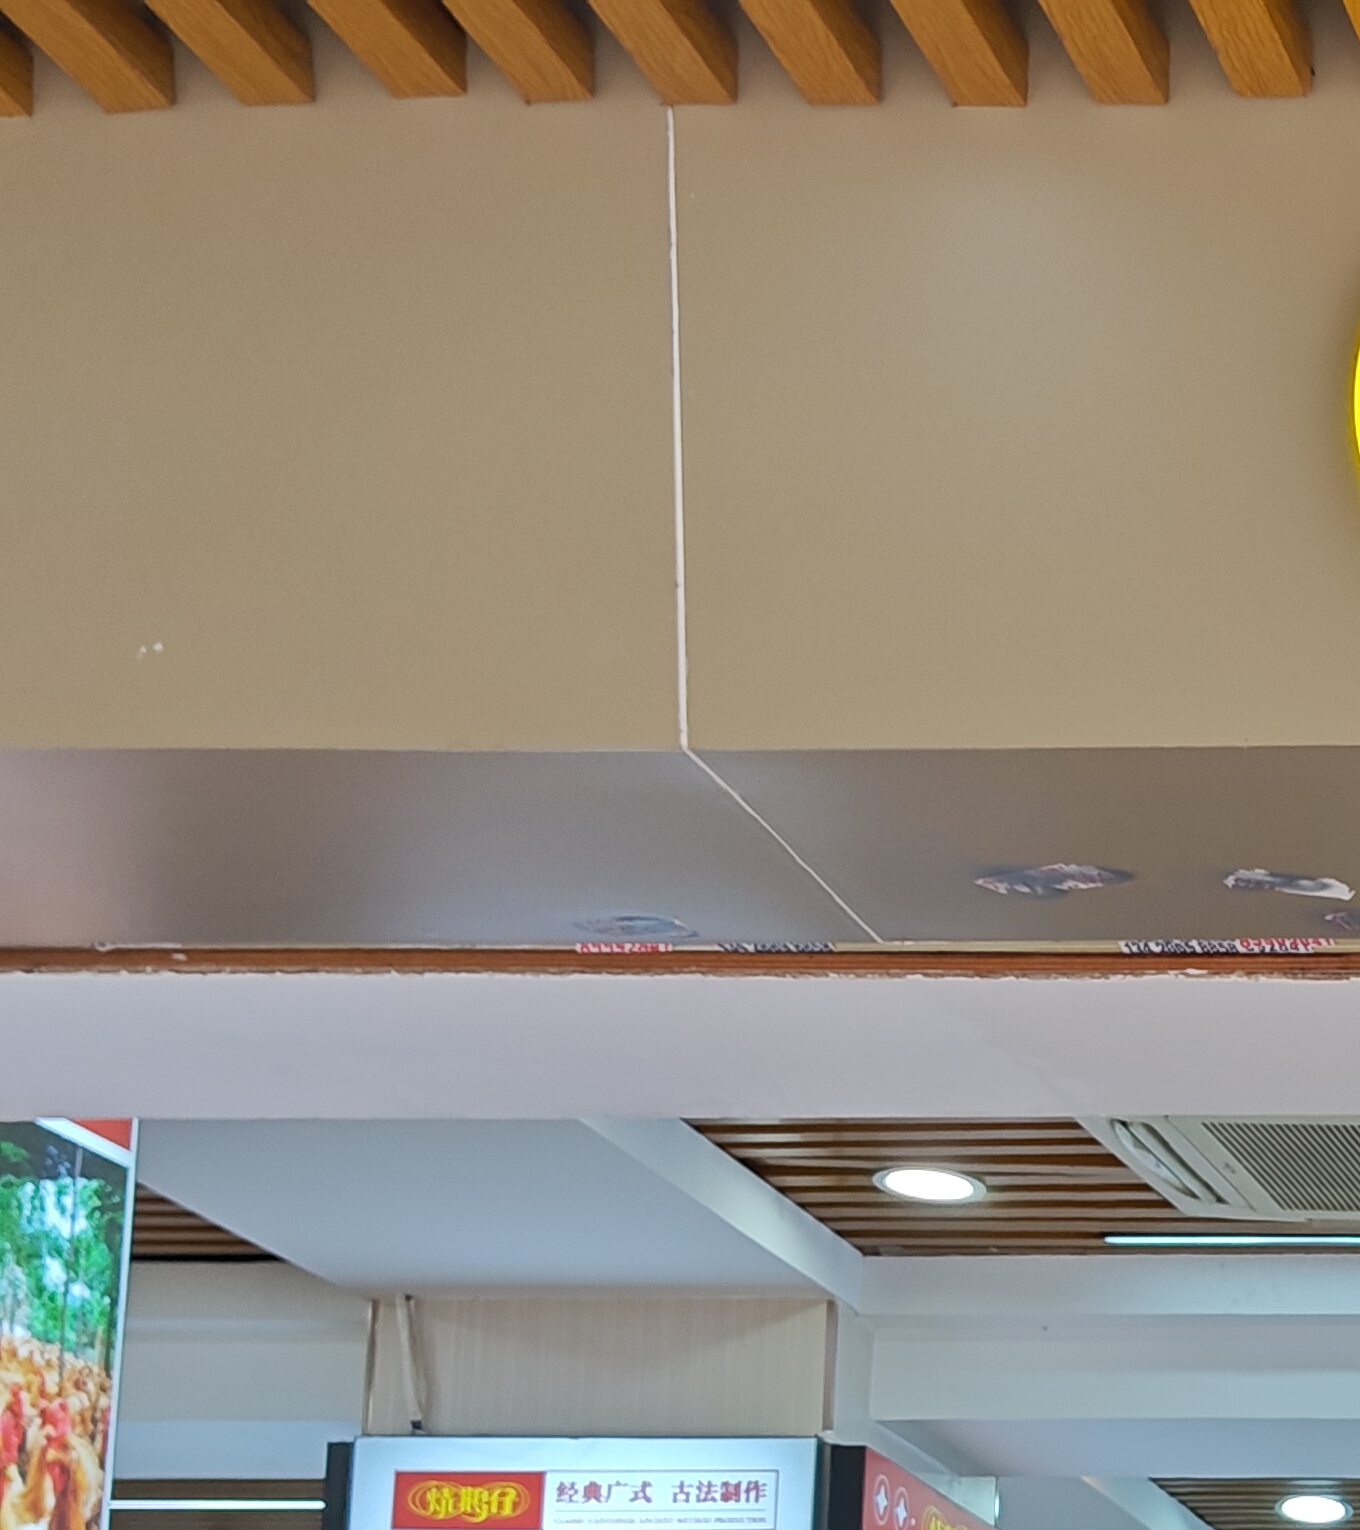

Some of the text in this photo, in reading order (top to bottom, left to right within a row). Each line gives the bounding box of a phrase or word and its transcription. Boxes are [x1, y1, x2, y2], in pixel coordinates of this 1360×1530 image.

[556, 1479, 769, 1505] 经典广式 古法制作
